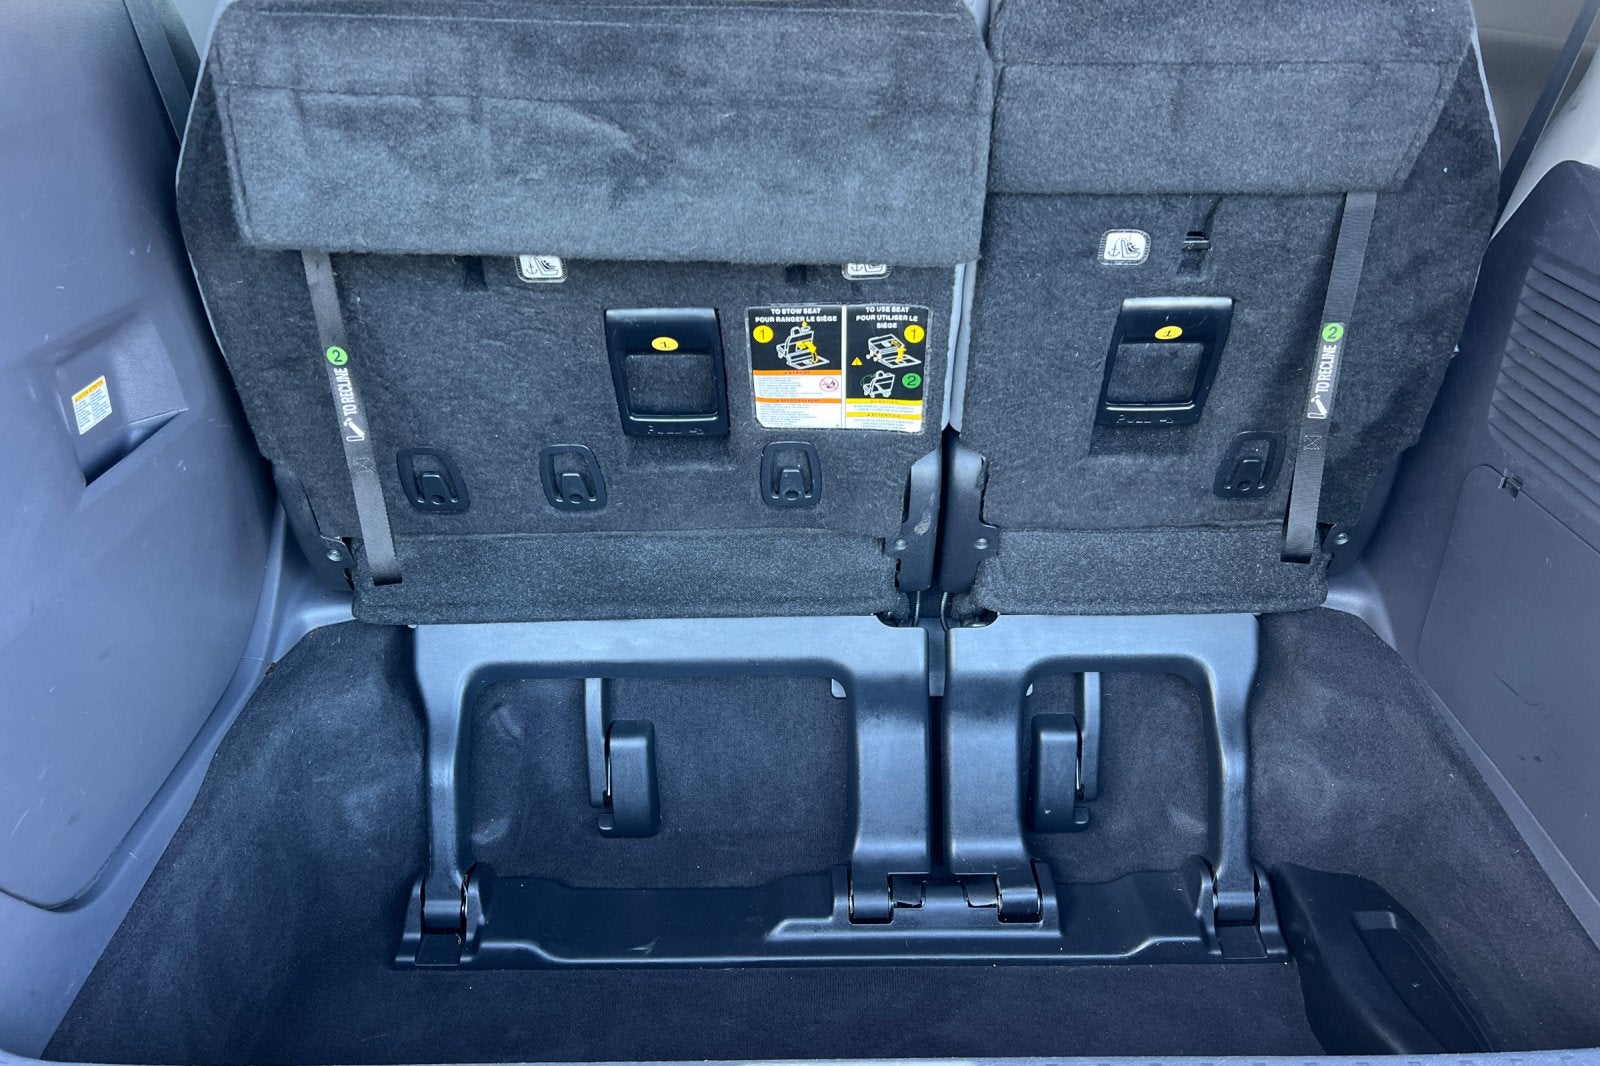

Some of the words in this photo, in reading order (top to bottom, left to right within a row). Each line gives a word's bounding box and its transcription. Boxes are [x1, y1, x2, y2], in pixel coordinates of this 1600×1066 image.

[855, 314, 876, 322] POUR
[1318, 344, 1337, 381] RECLINE
[333, 367, 355, 404] RECLINE
[1315, 381, 1330, 393] TO
[342, 404, 357, 417] TO
